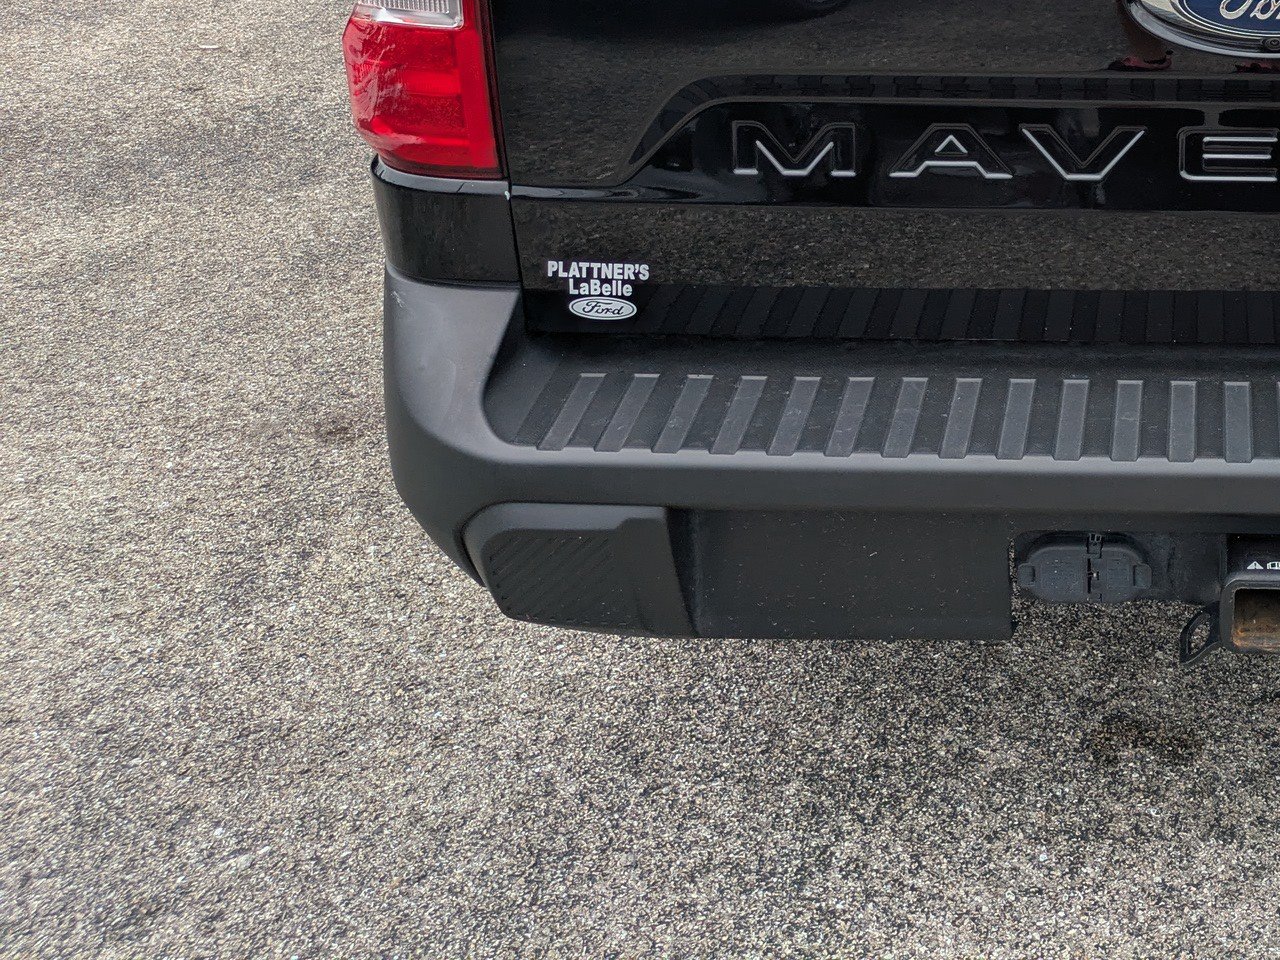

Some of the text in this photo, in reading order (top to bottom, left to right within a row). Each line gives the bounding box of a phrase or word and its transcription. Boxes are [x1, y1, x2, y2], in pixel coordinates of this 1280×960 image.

[547, 260, 650, 281] PLATTNER'S
[568, 278, 633, 296] LaBelle
[582, 300, 624, 316] Ford
